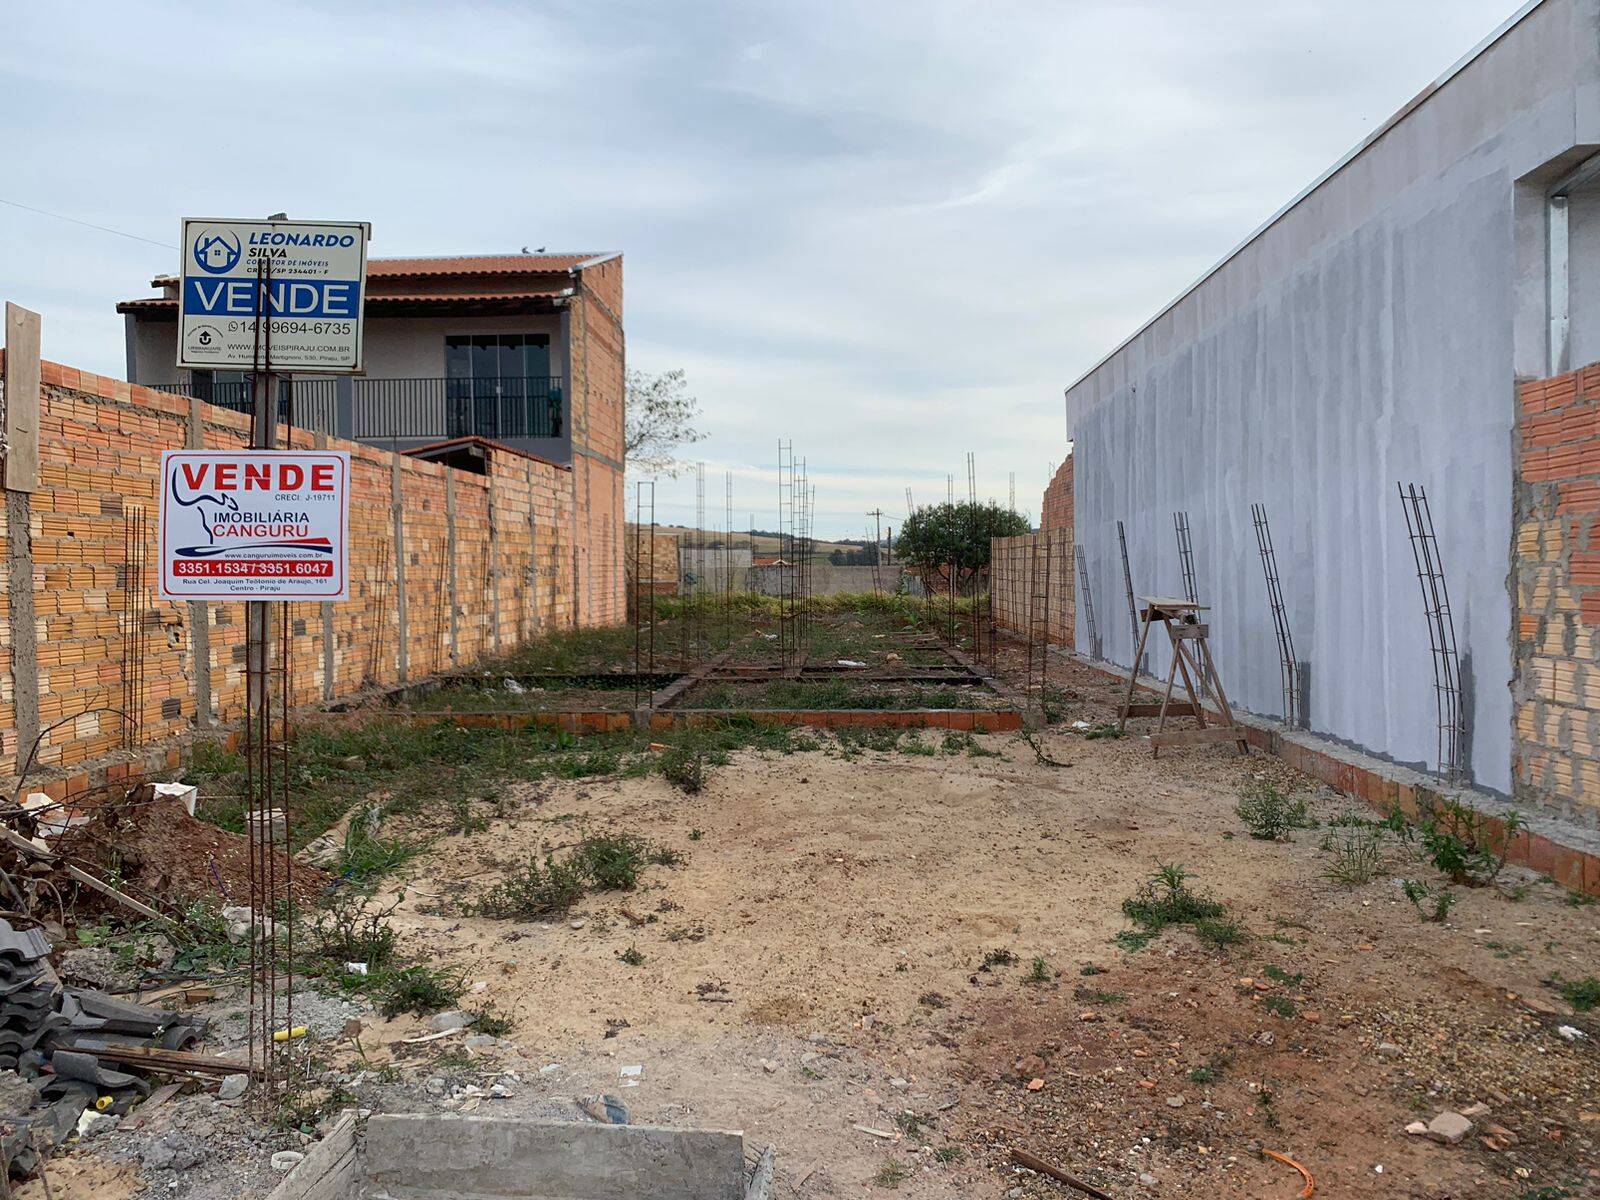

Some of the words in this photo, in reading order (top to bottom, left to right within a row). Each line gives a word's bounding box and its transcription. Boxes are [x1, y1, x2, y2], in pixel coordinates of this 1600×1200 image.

[248, 232, 355, 248] LEONARDO
[248, 247, 287, 258] SILVA
[246, 259, 286, 267] CORTOR
[298, 259, 329, 267] IMÓVEIS
[194, 281, 350, 314] VENDE
[240, 321, 257, 333] 14
[181, 463, 335, 491] VENDE
[213, 509, 310, 523] IMOBILIÁRIA
[212, 524, 309, 538] CANGURU
[224, 552, 323, 560] www.canguruimoveis.com.br
[178, 562, 248, 575] 3351.1534
[258, 562, 329, 575] 3351.6047
[213, 578, 244, 587] Joaquim
[259, 585, 281, 593] Piraju
